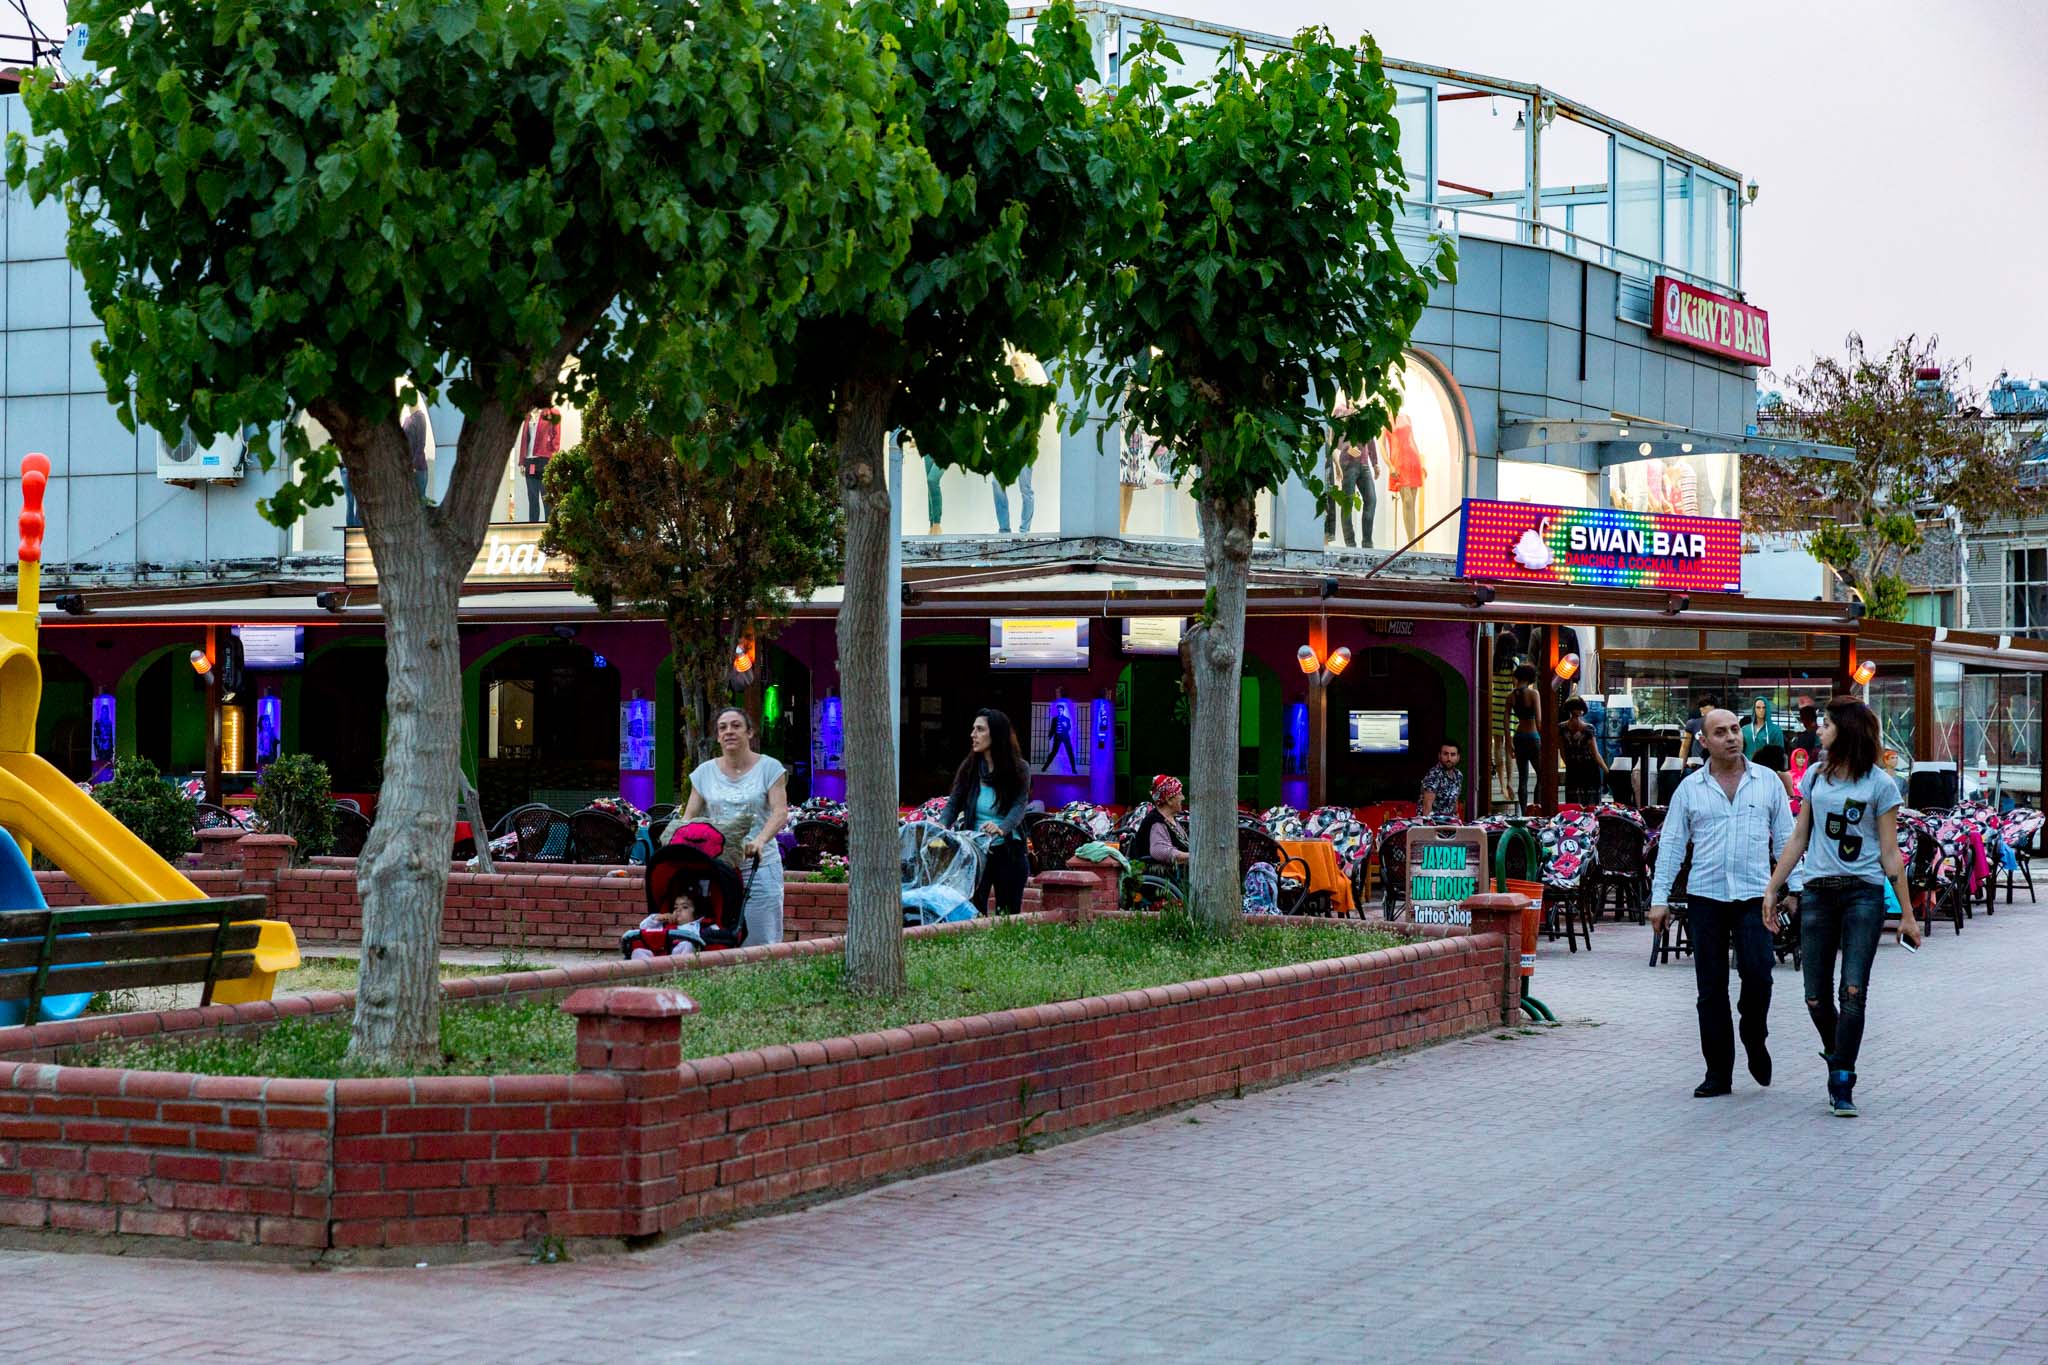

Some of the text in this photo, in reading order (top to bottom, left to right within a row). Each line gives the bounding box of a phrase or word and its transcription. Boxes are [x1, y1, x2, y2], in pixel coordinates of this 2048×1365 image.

[1734, 308, 1767, 359] BAR
[1570, 525, 1706, 558] SWAN BAR
[1565, 552, 1702, 574] DANCING & COCKAIL BAR
[1387, 621, 1414, 635] MUSIC
[1421, 846, 1467, 870] JAYDEN
[1411, 876, 1476, 901] INK HOUSE
[1414, 904, 1473, 927] Tattoo Shop
